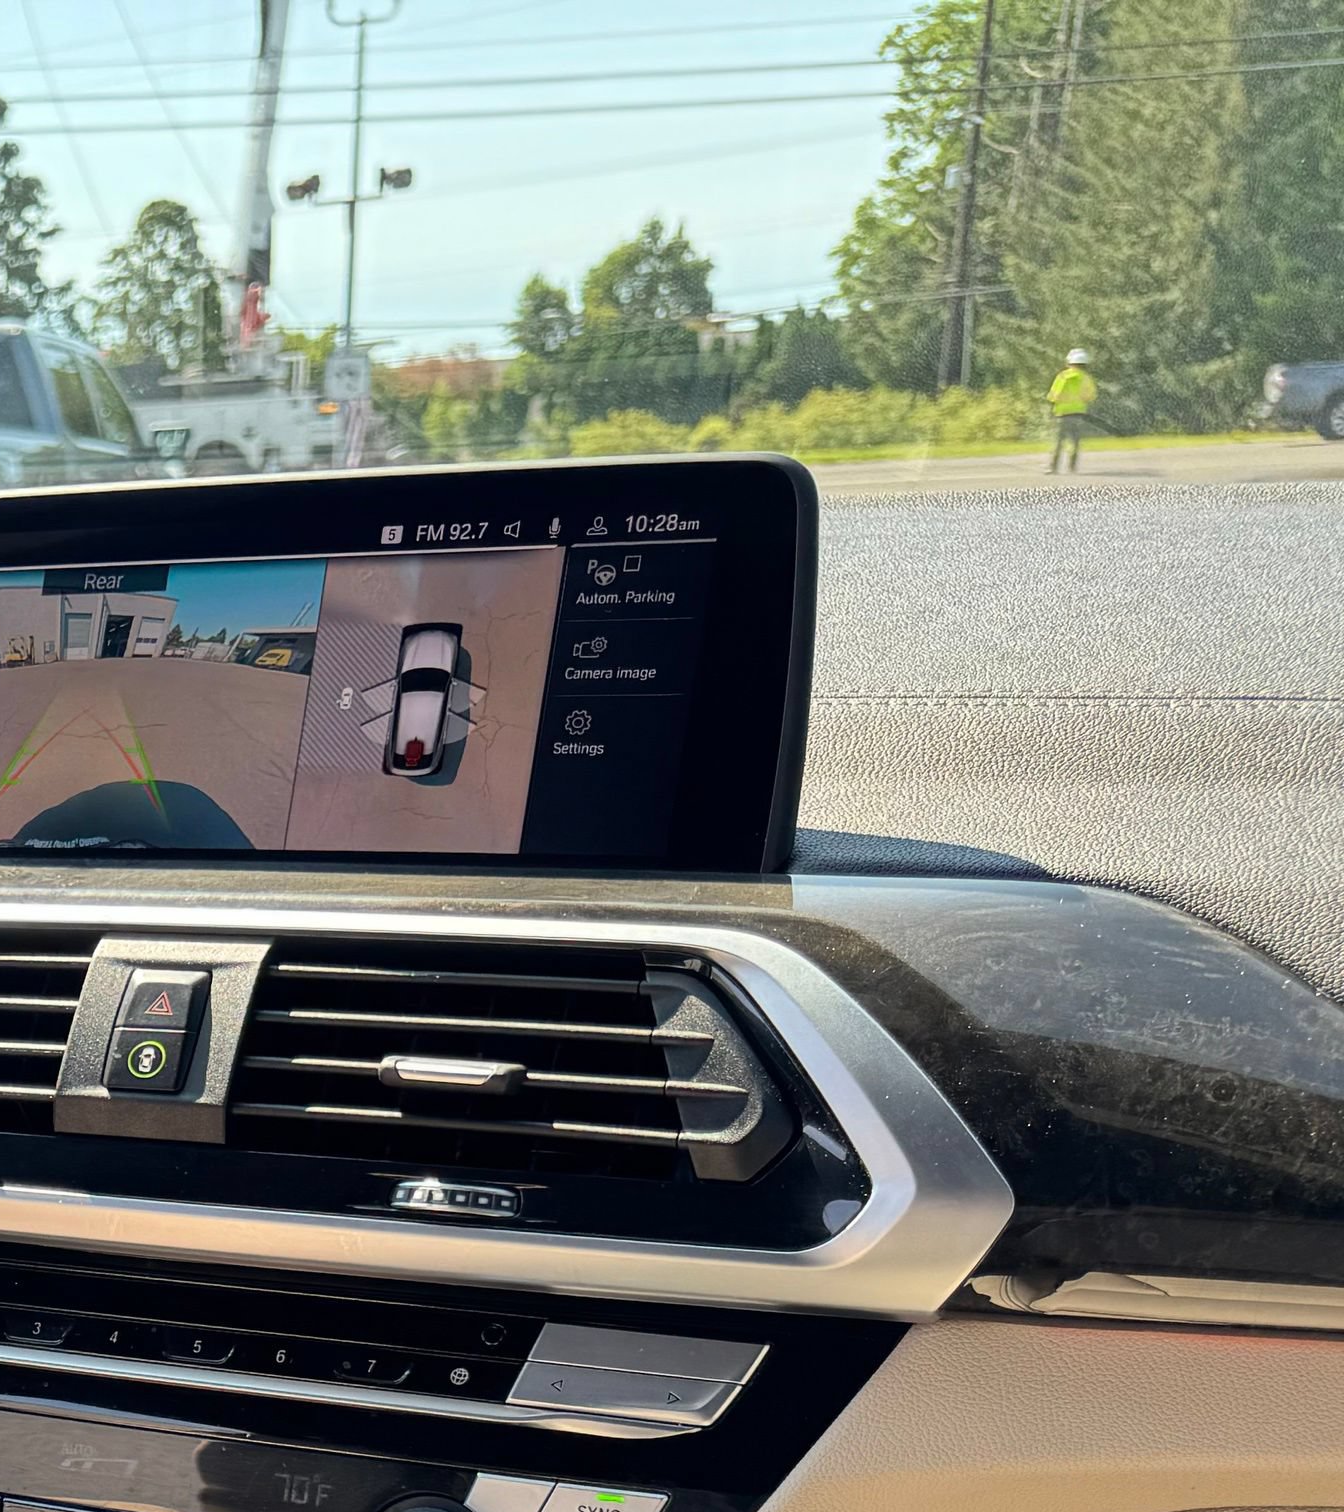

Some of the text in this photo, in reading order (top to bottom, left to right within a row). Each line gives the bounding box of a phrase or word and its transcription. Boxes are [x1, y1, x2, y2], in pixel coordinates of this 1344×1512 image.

[625, 514, 700, 534] 10:28am
[416, 522, 489, 542] FM 92.7
[84, 573, 124, 590] Rear
[576, 590, 675, 607] Autom. Parking
[565, 667, 657, 682] Camera image
[553, 741, 604, 757] Settings
[32, 1321, 42, 1336] 3
[109, 1330, 119, 1344] 4
[192, 1339, 203, 1354] 5
[275, 1349, 287, 1364] 6
[366, 1359, 377, 1374] 7
